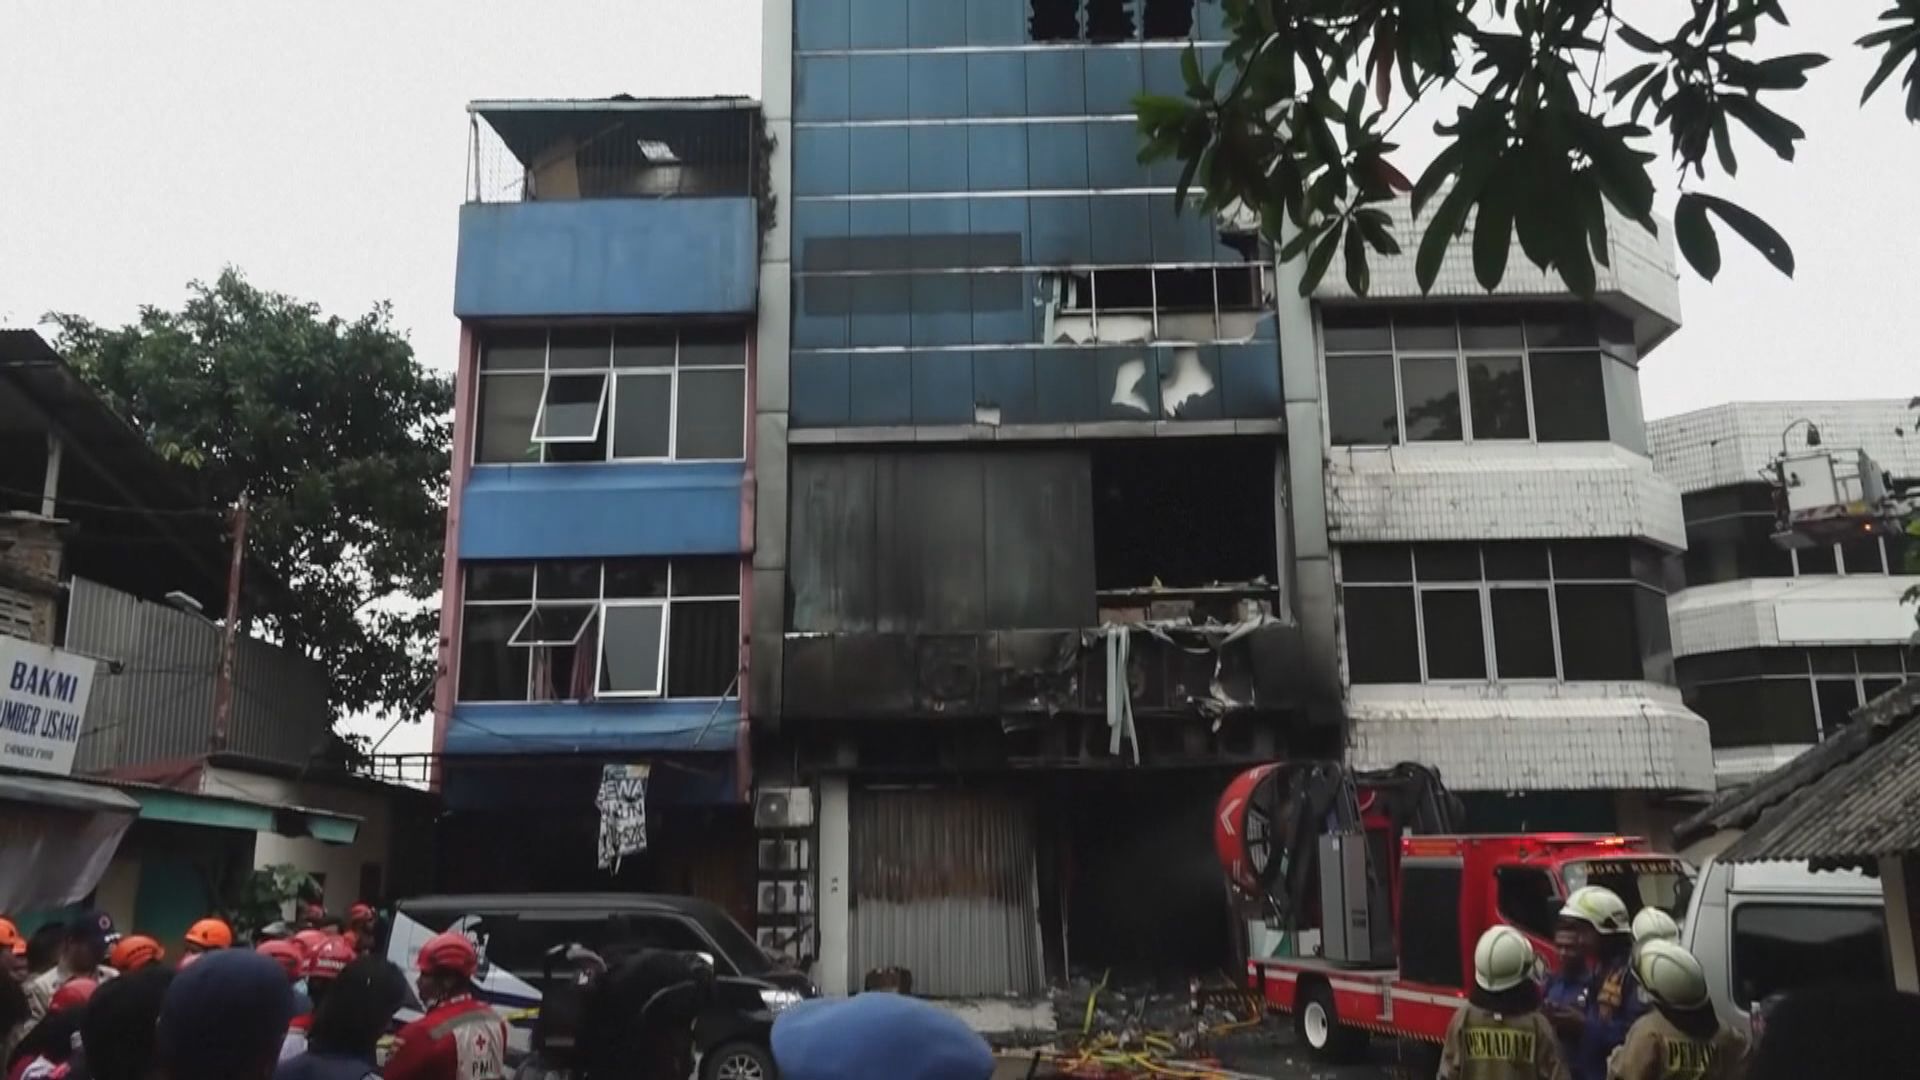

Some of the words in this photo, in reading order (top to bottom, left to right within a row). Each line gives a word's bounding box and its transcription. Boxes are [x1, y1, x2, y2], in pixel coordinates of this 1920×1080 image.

[10, 660, 78, 704] BAKMI
[40, 708, 80, 743] USAHA
[1465, 1030, 1534, 1060] PEMADAM
[472, 1060, 494, 1077] PMI
